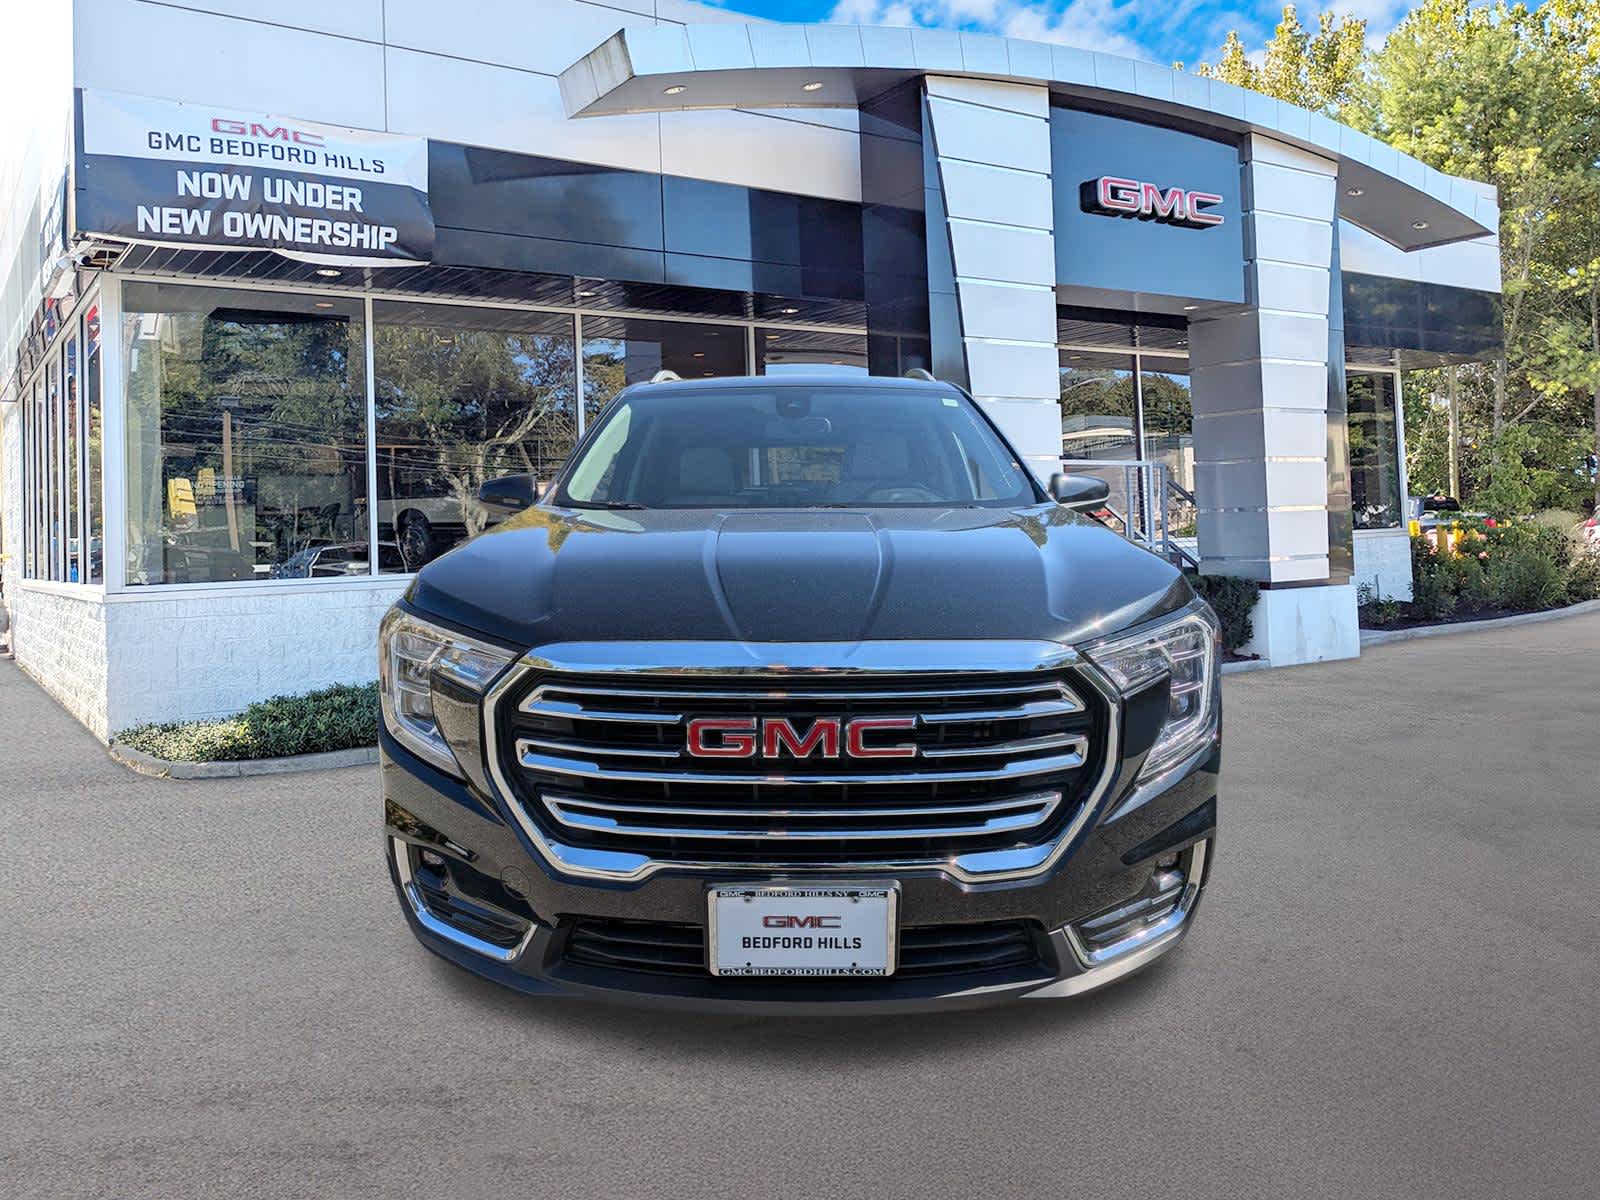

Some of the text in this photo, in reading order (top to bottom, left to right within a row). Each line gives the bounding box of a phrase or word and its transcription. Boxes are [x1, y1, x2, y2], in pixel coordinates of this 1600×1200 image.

[148, 131, 385, 174] GMC BEDFORD HILLS
[211, 118, 325, 147] GMC
[176, 170, 363, 213] NOW UNDER
[1097, 176, 1224, 224] GMC
[136, 205, 398, 250] NEW OWNERSHIP
[686, 717, 918, 758] GMC
[719, 890, 746, 898] GMC
[763, 915, 842, 928] GMC
[742, 937, 862, 949] BEDFORD HILLS
